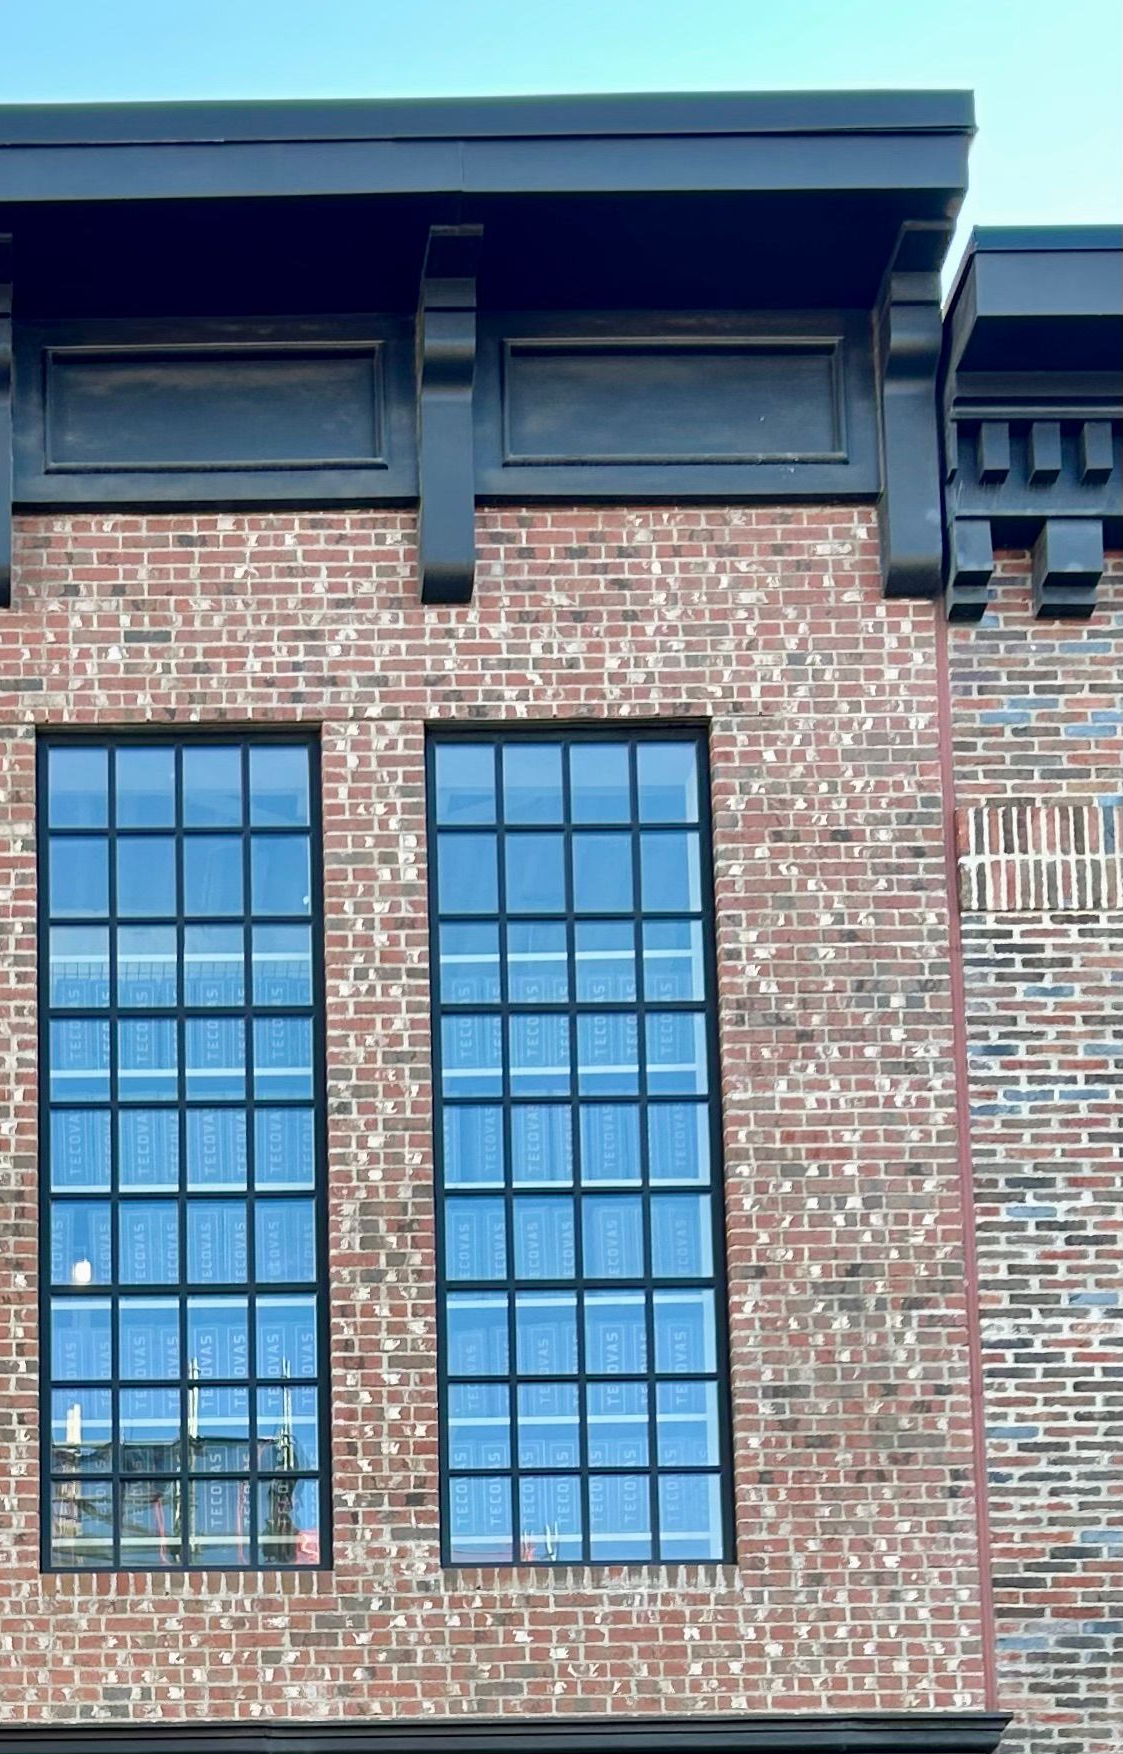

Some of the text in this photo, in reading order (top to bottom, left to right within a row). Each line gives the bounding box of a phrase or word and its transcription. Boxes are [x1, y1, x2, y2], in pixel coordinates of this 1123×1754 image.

[135, 1339, 146, 1409] TEOVAS
[201, 1335, 212, 1407] TEOVAS
[234, 1334, 245, 1407] TEOVAS
[268, 1334, 280, 1407] TEOVAS
[606, 1332, 619, 1405] TEOVAS
[211, 1454, 222, 1527] TECOAS
